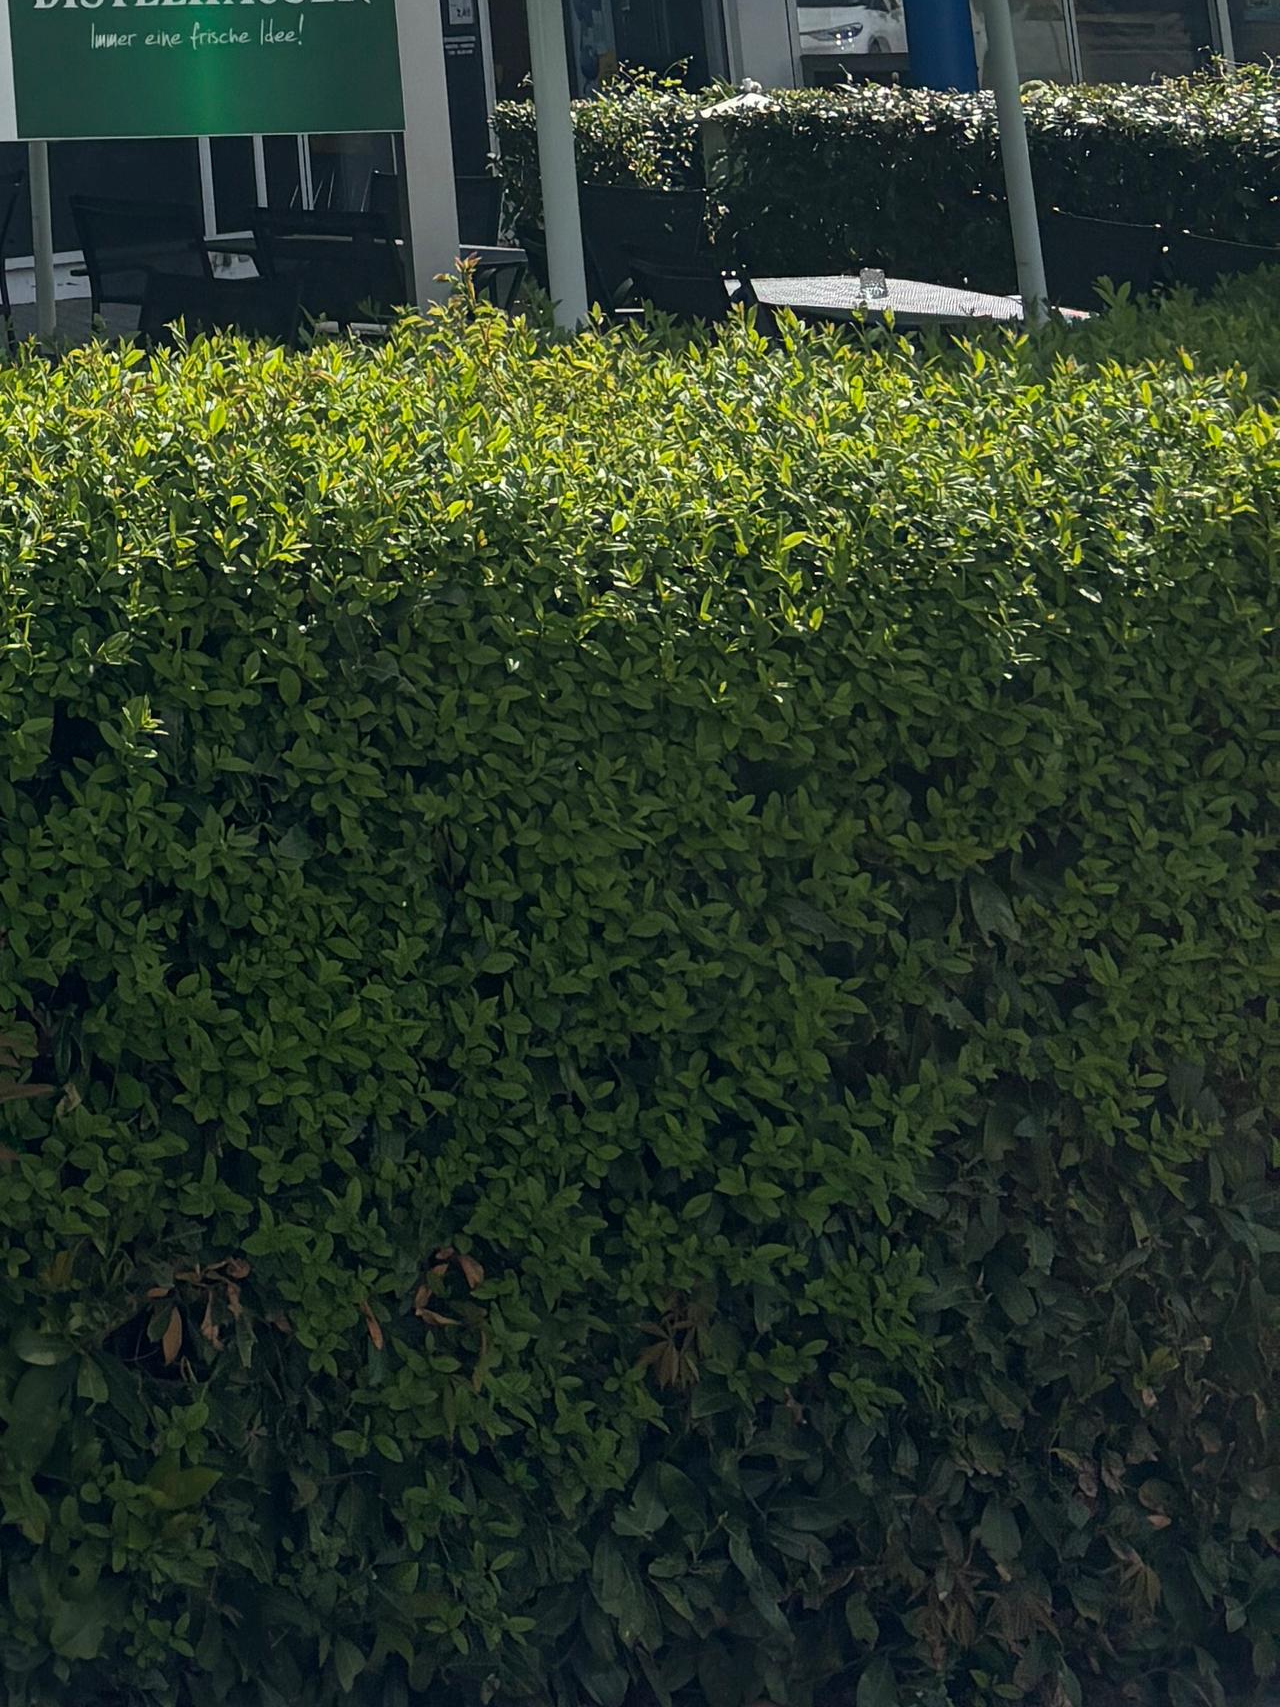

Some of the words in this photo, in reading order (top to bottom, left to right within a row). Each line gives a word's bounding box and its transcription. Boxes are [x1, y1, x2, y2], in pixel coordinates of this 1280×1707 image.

[90, 22, 137, 50] Immer
[144, 30, 182, 49] eine
[191, 21, 252, 51] frische
[259, 13, 304, 46] Idee!
